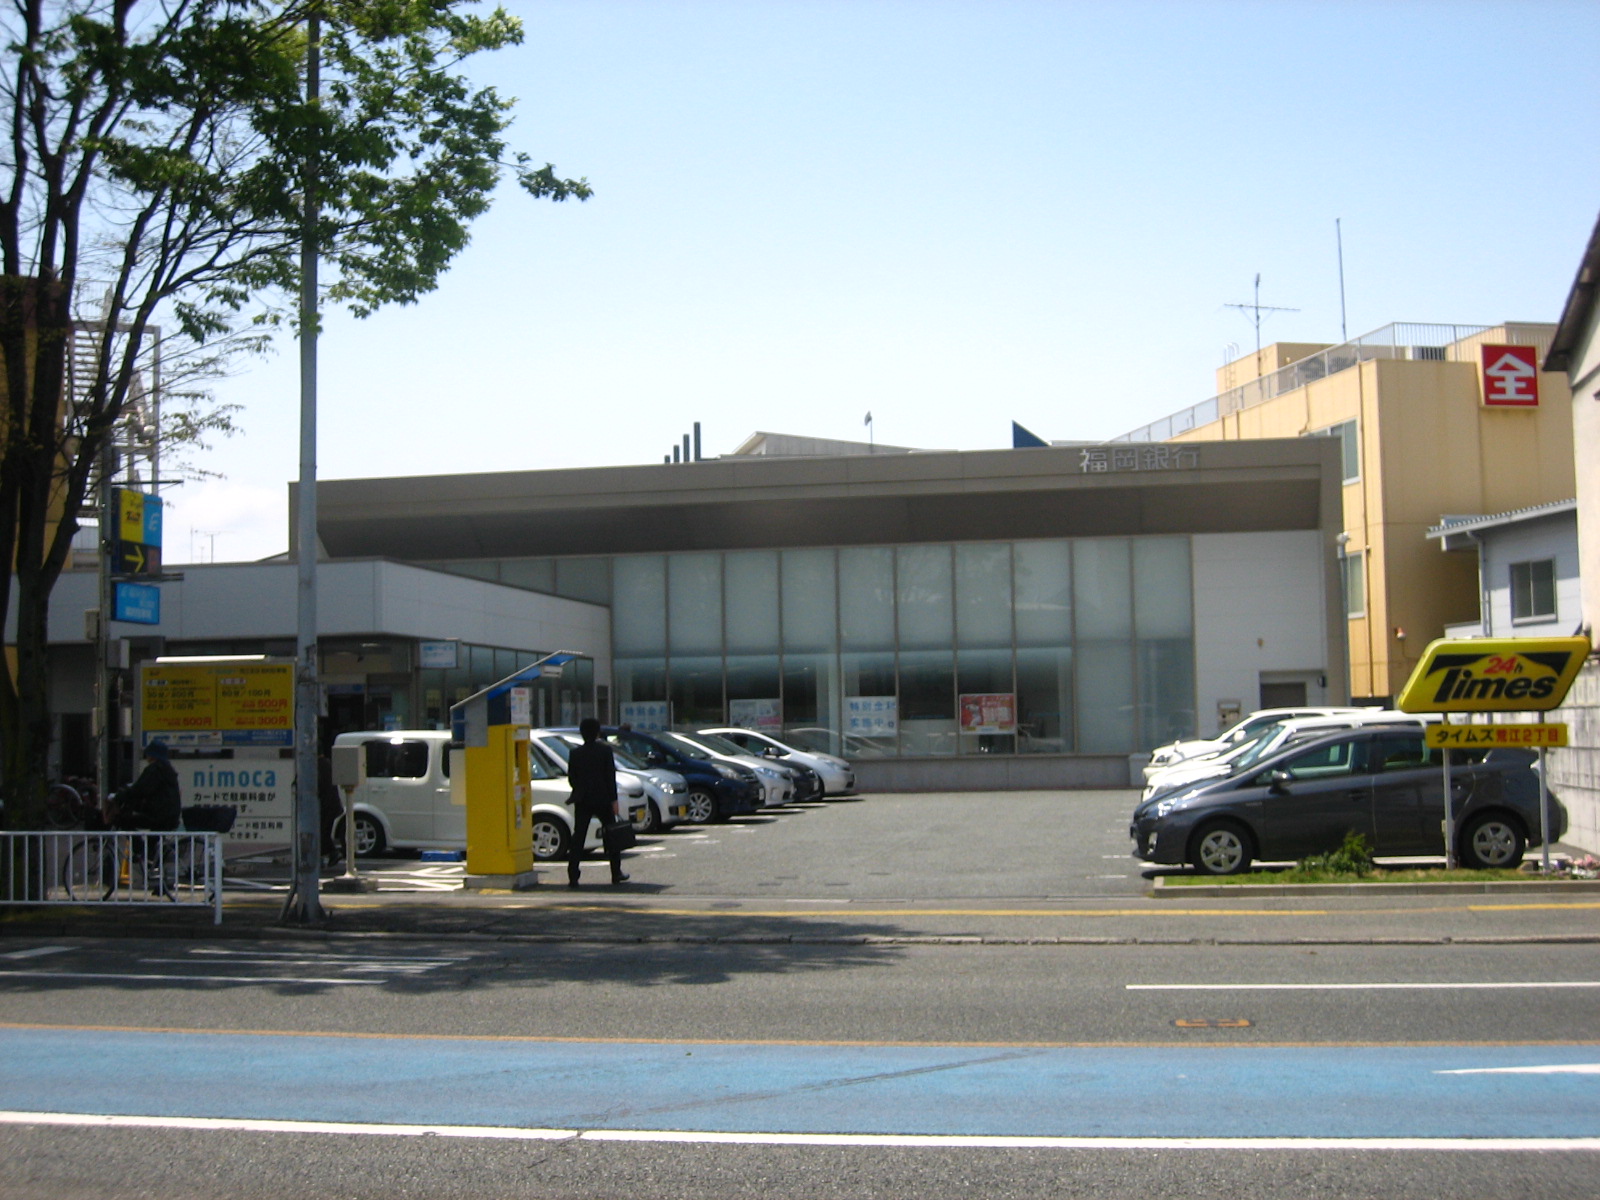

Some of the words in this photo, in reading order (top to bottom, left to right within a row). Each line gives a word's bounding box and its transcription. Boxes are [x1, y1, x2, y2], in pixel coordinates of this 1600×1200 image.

[1486, 352, 1535, 400] 全
[1080, 445, 1200, 473] 福岡銀行
[1484, 655, 1523, 674] 24h
[1433, 668, 1557, 703] Times
[194, 765, 276, 788] nimoca
[194, 792, 276, 802] カードで駐車料金が
